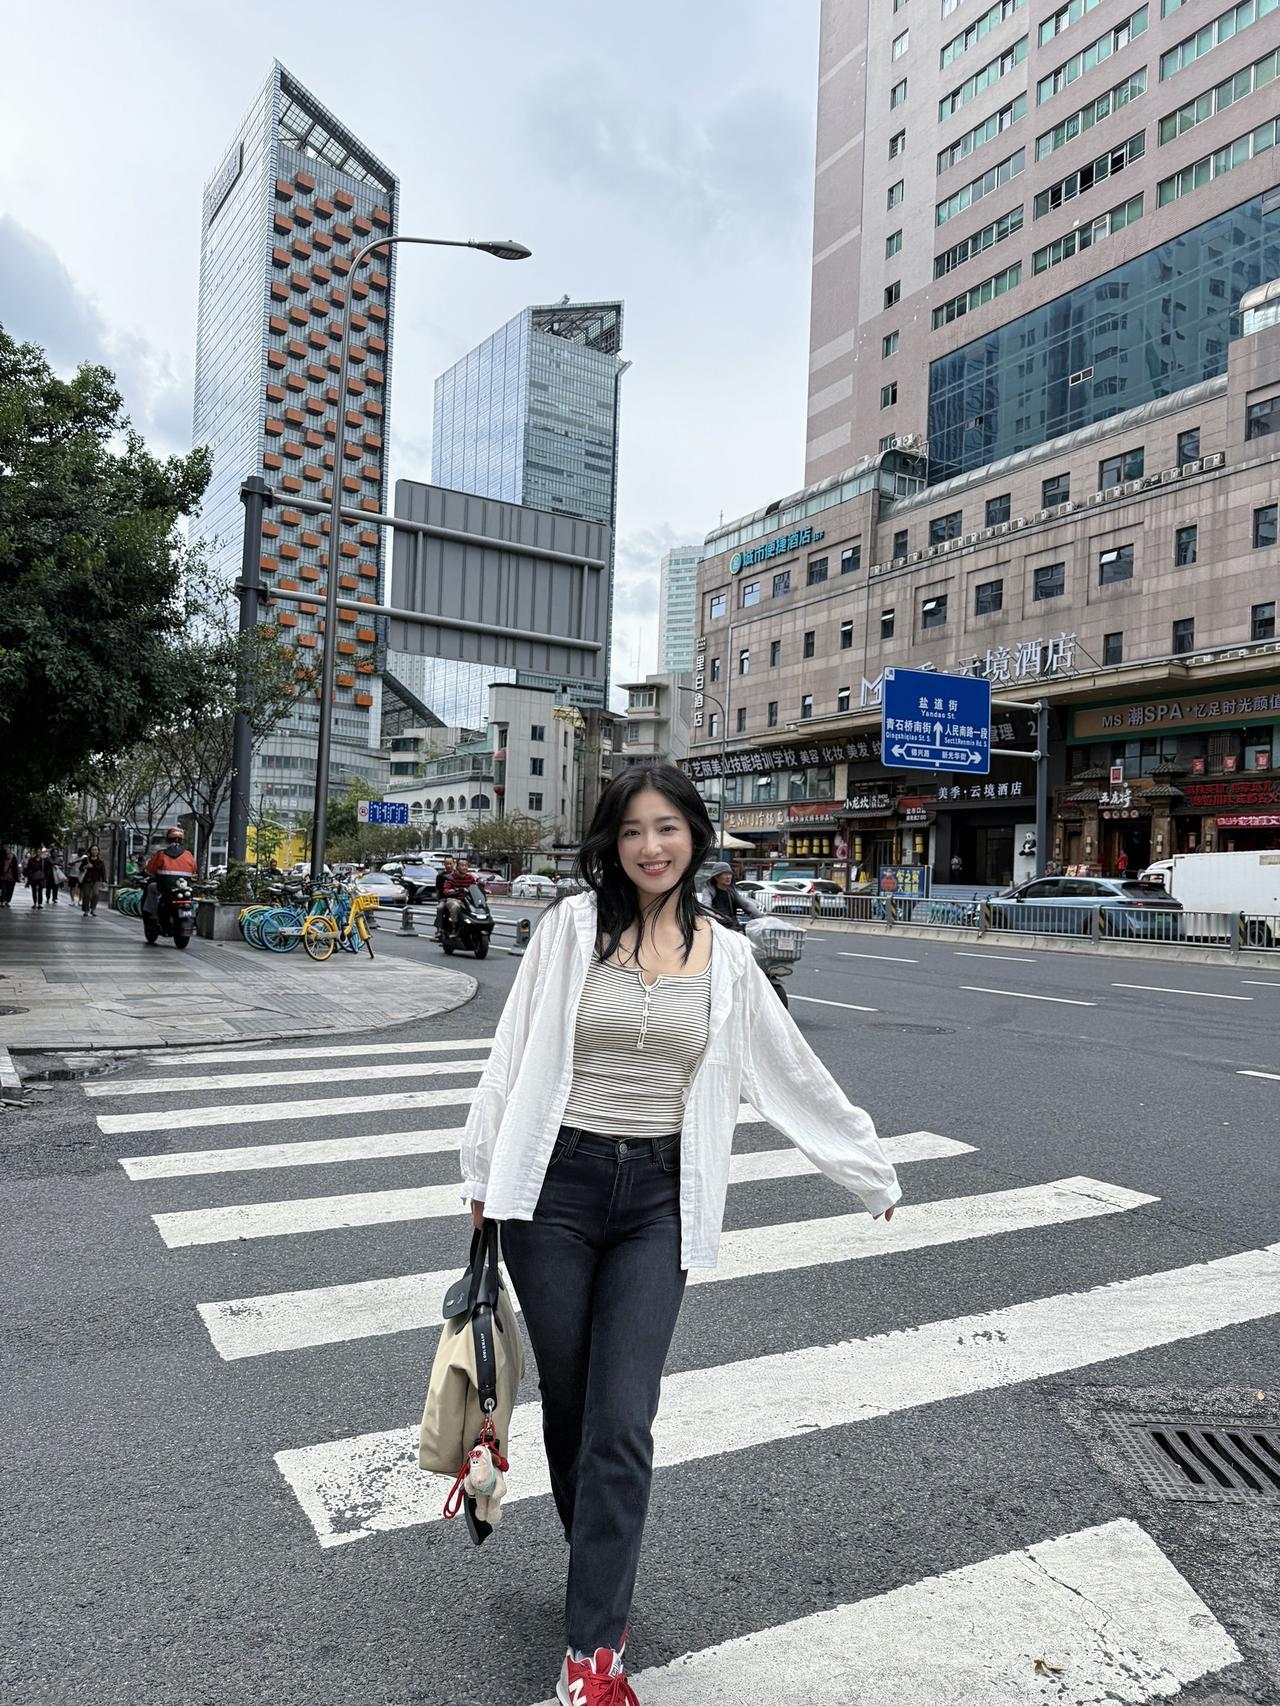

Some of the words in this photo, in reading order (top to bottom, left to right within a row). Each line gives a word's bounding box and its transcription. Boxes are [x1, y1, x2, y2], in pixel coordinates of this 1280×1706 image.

[742, 526, 812, 567] 城市便捷酒店
[918, 696, 958, 712] 盐道街
[921, 709, 945, 718] Yandao
[1102, 714, 1123, 728] MS
[886, 718, 931, 734] 青石桥南街
[945, 723, 988, 740] 人民南路一段
[799, 749, 820, 765] 美容
[822, 745, 845, 762] 化妆
[846, 742, 870, 759] 美发
[843, 796, 870, 810] 小龙坎
